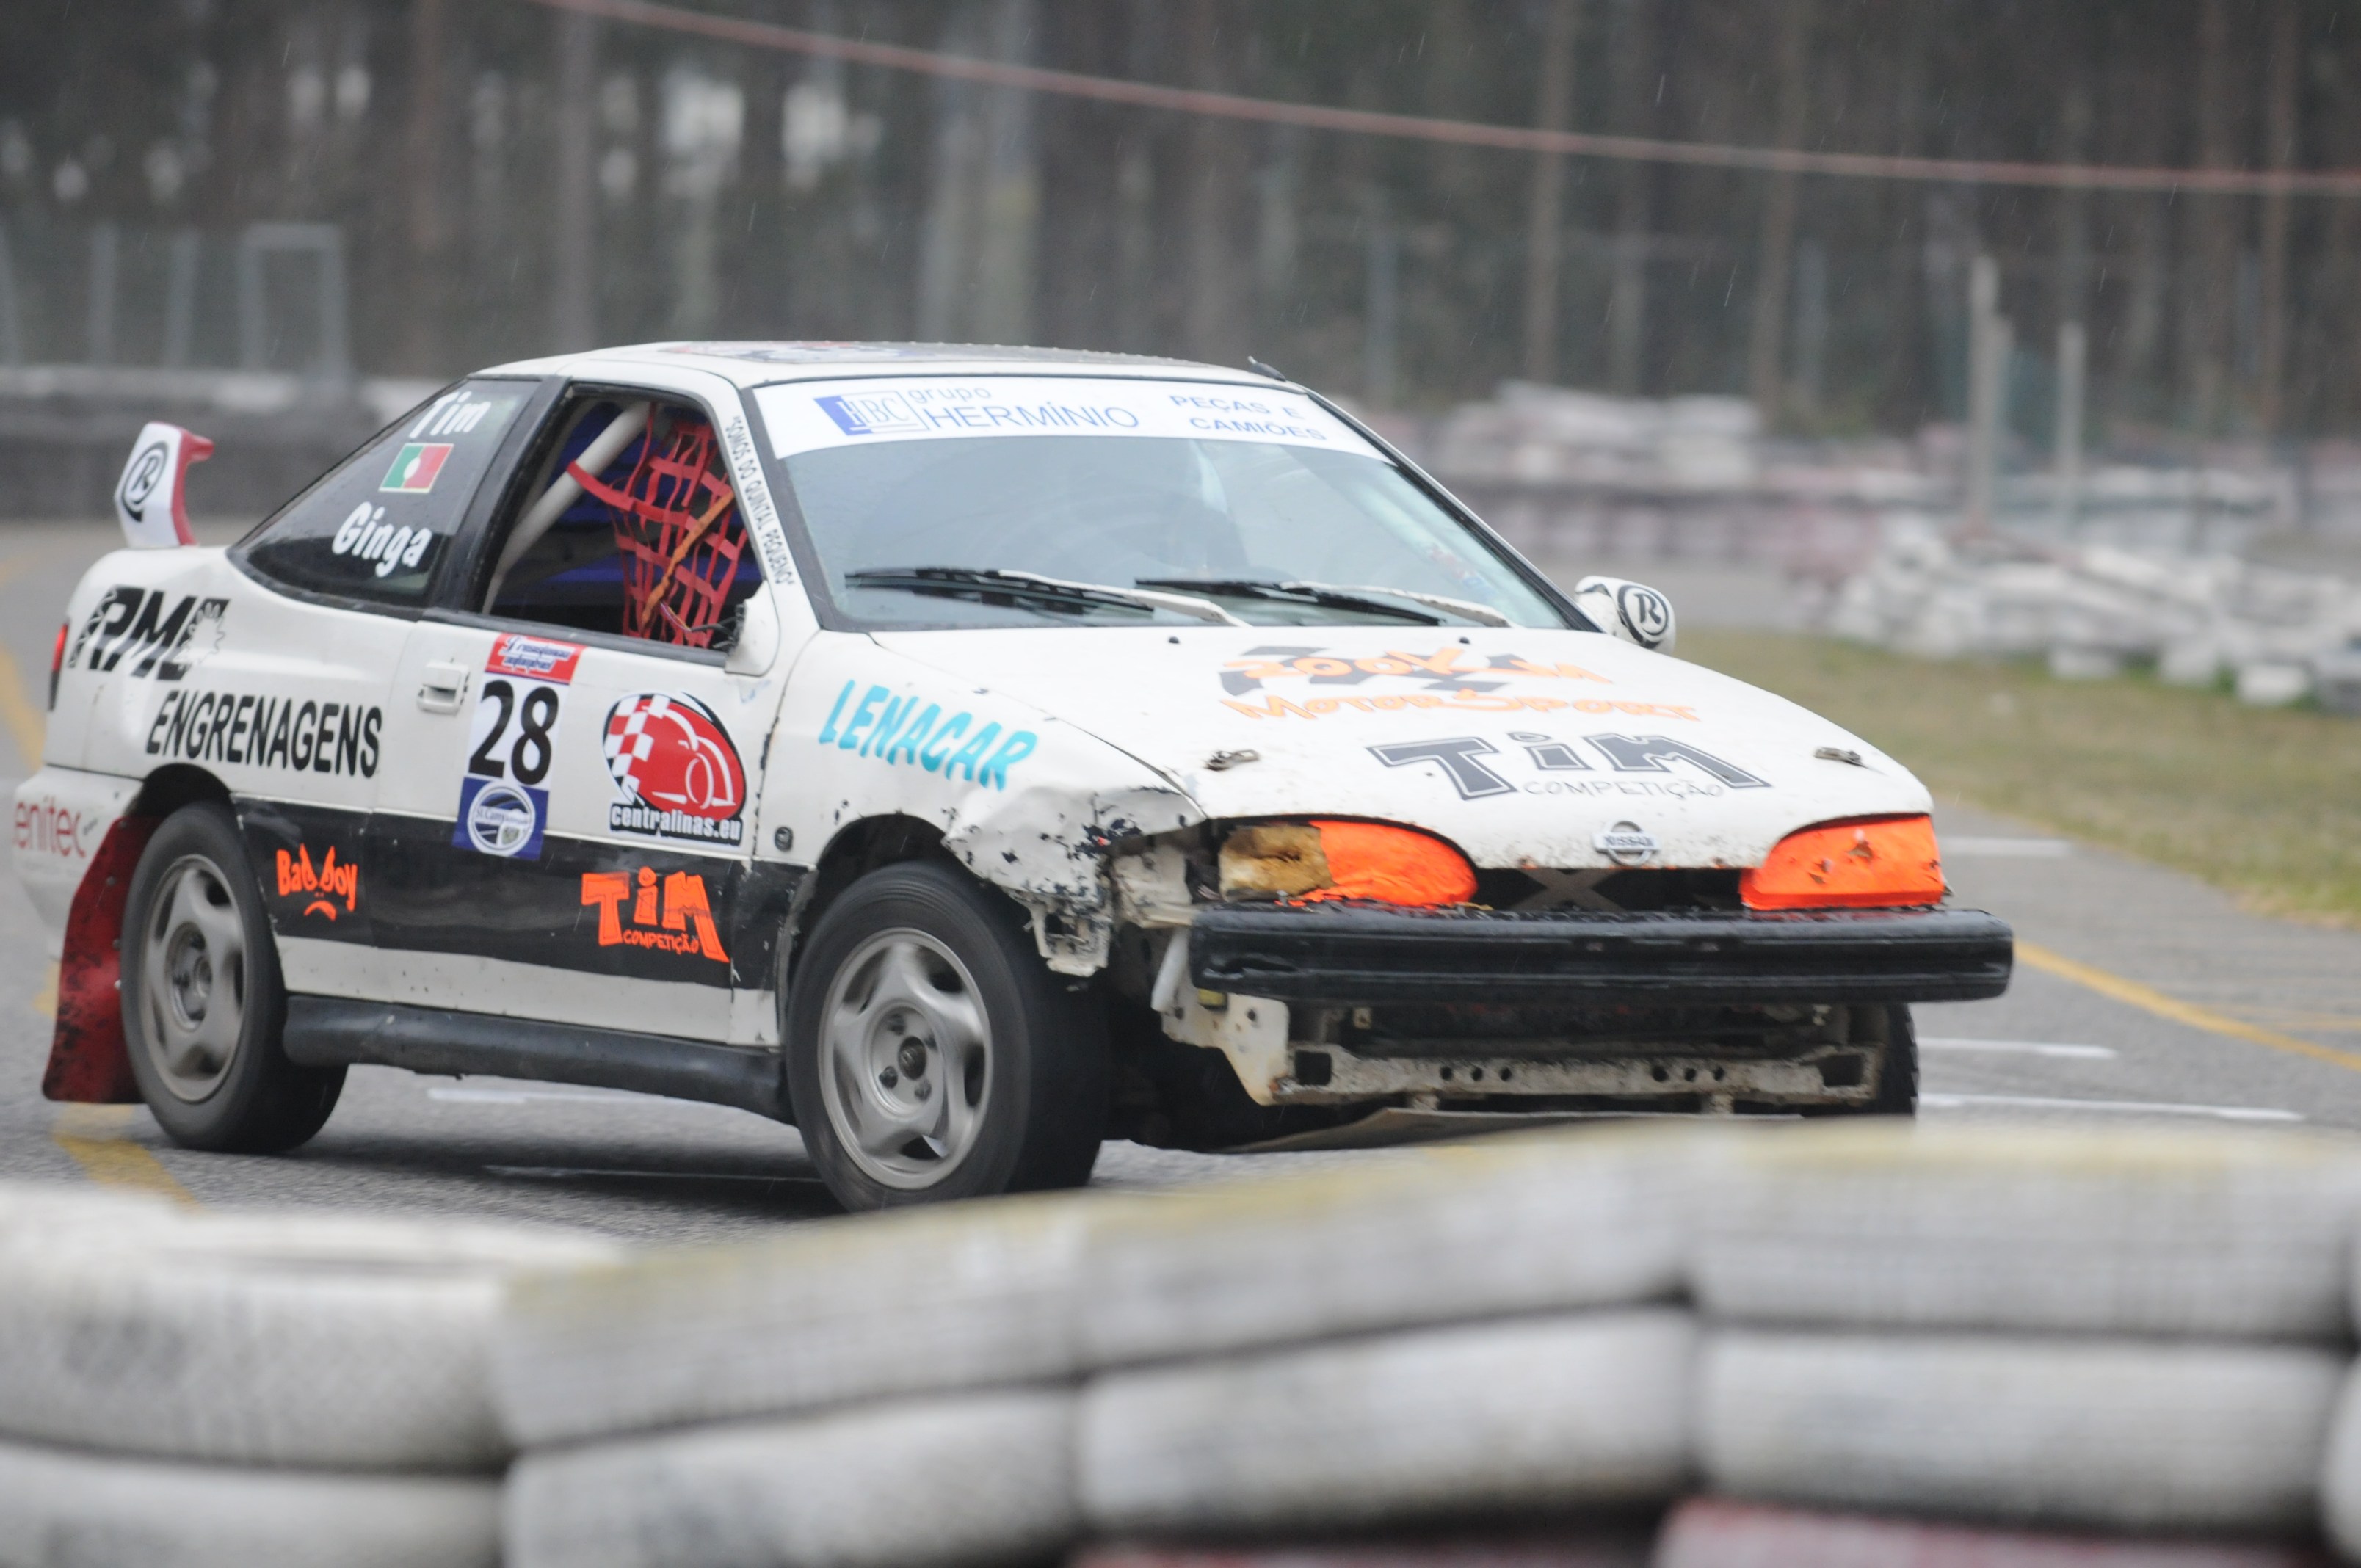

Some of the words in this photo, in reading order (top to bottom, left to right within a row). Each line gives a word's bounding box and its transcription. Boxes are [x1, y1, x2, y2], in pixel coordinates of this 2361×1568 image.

[408, 391, 492, 440] Tim
[907, 387, 992, 404] grupo
[922, 401, 1140, 429] HERMÍNIO
[1169, 395, 1272, 415] PEÇAS
[1282, 407, 1305, 421] E
[1189, 417, 1328, 441] CAMIÕES
[331, 501, 433, 578] Ginga
[146, 688, 383, 779] ENGRENAGENS
[468, 679, 559, 785] 28
[819, 679, 1039, 792] LENACAR
[611, 805, 741, 841] centralinas.eu
